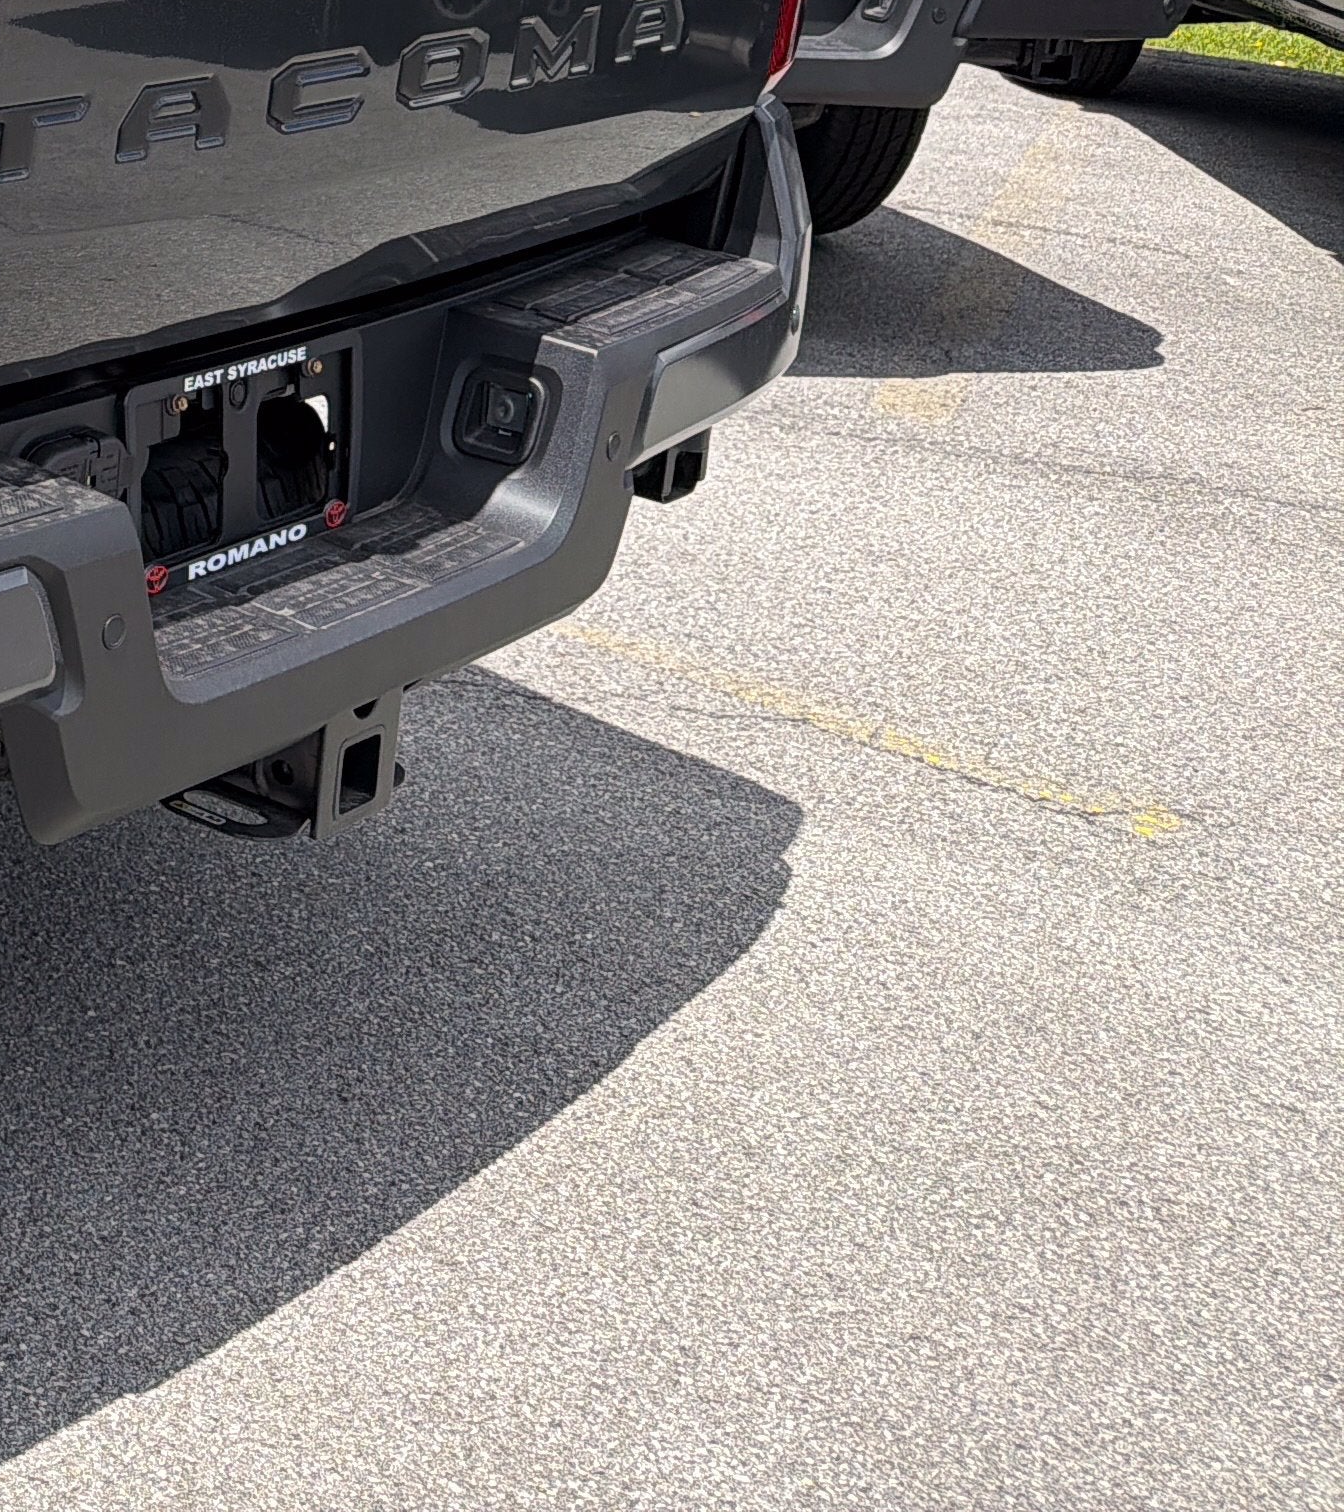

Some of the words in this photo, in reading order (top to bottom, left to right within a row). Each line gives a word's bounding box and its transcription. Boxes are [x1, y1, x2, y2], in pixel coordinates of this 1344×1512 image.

[183, 369, 224, 392] EAST
[227, 346, 307, 381] SYRACUSE
[188, 523, 307, 580] ROMANO
